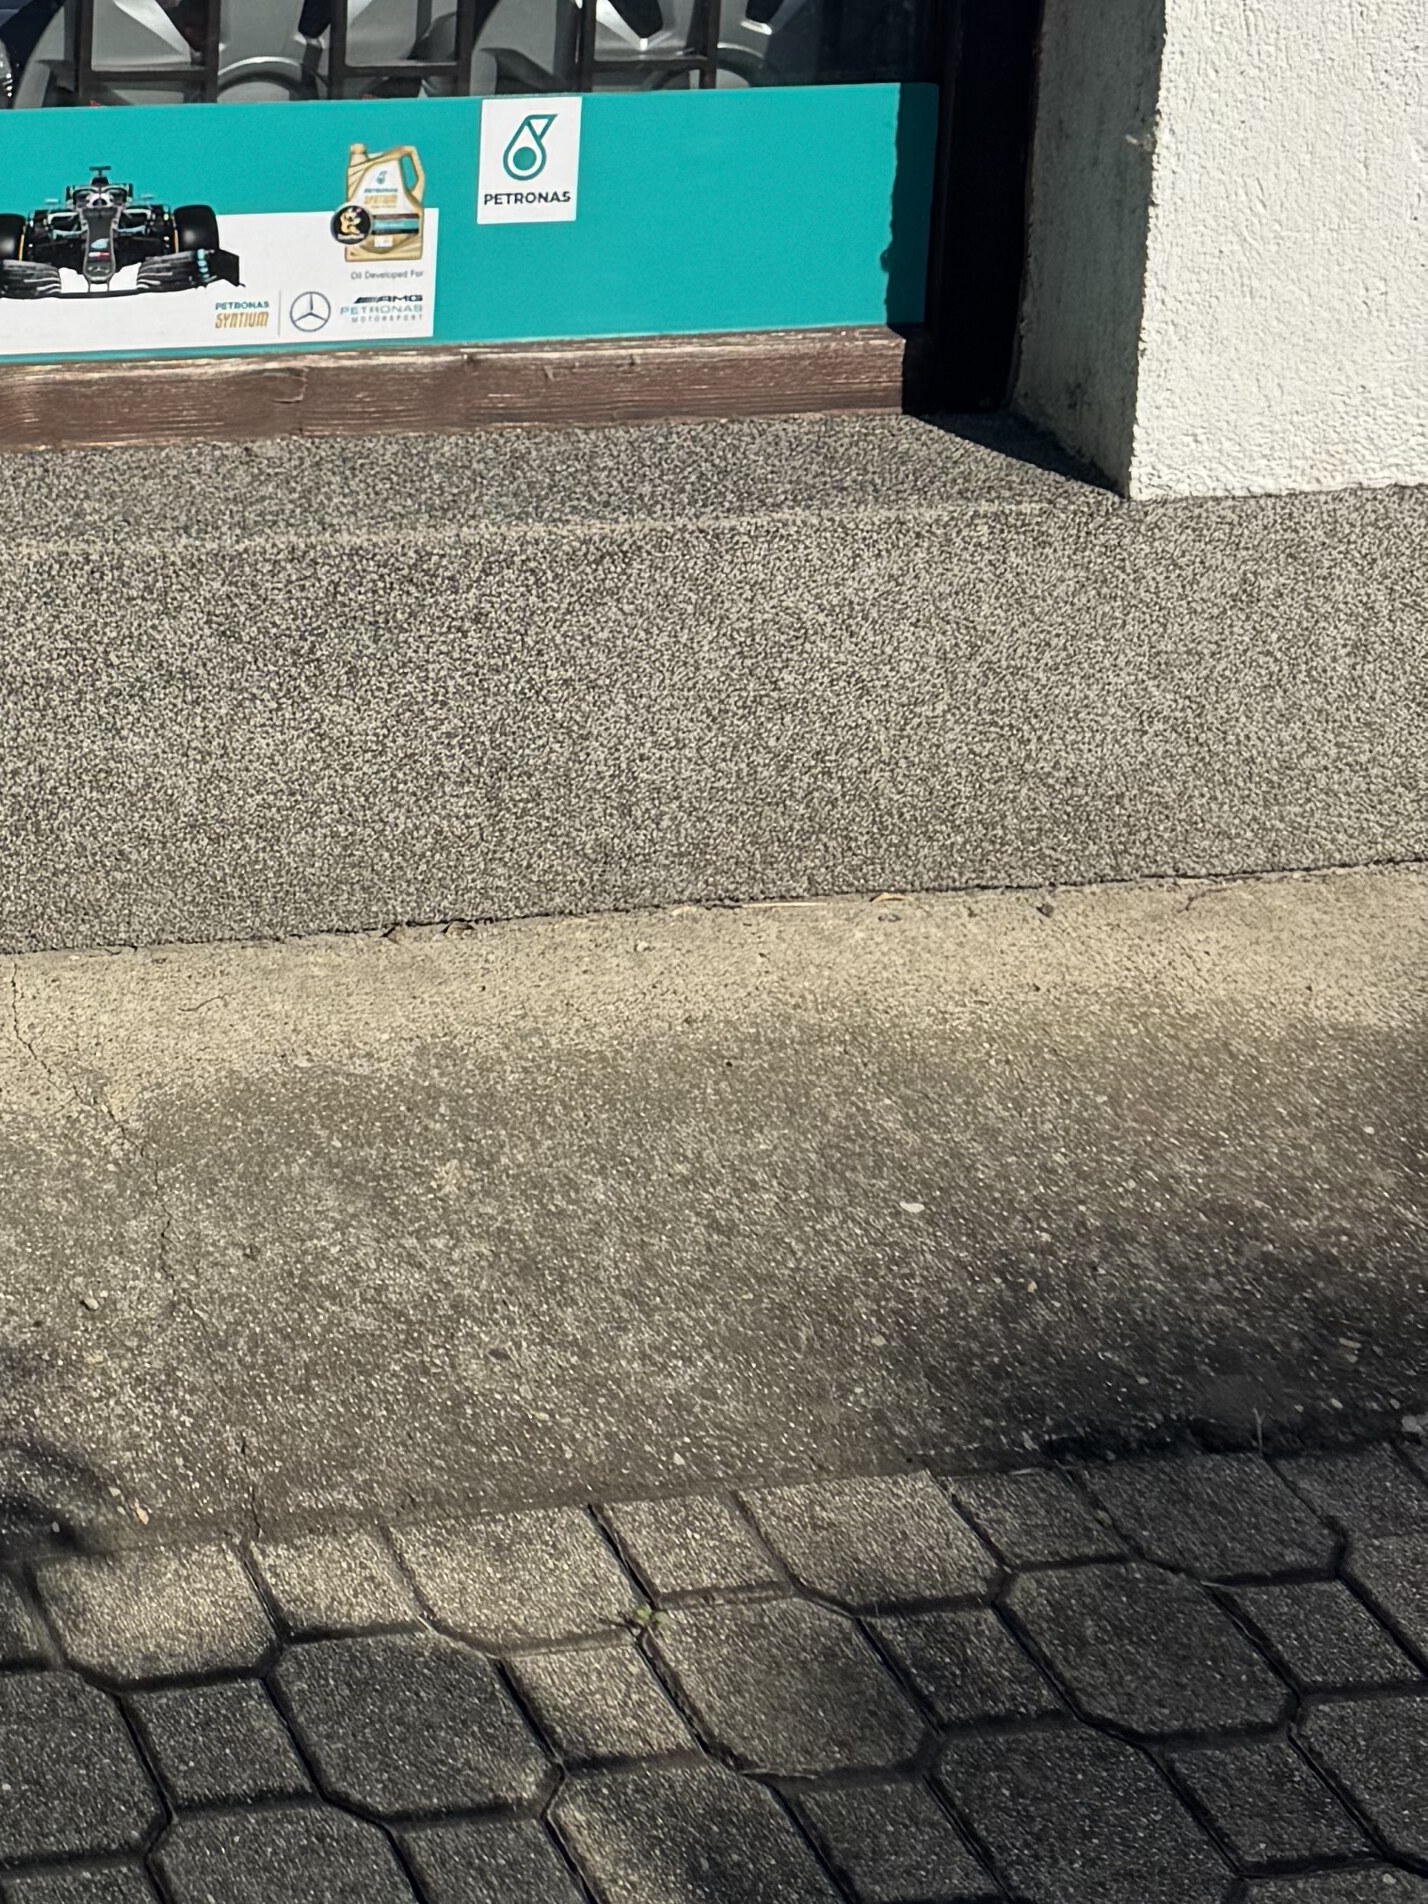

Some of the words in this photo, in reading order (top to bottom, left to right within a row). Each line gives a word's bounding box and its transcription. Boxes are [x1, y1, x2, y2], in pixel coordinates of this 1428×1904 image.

[484, 191, 571, 205] PETRONAS
[365, 270, 408, 280] Developed
[215, 301, 269, 310] PETRONAS
[340, 304, 424, 315] PETRONAS
[215, 311, 269, 329] SYNTIUM
